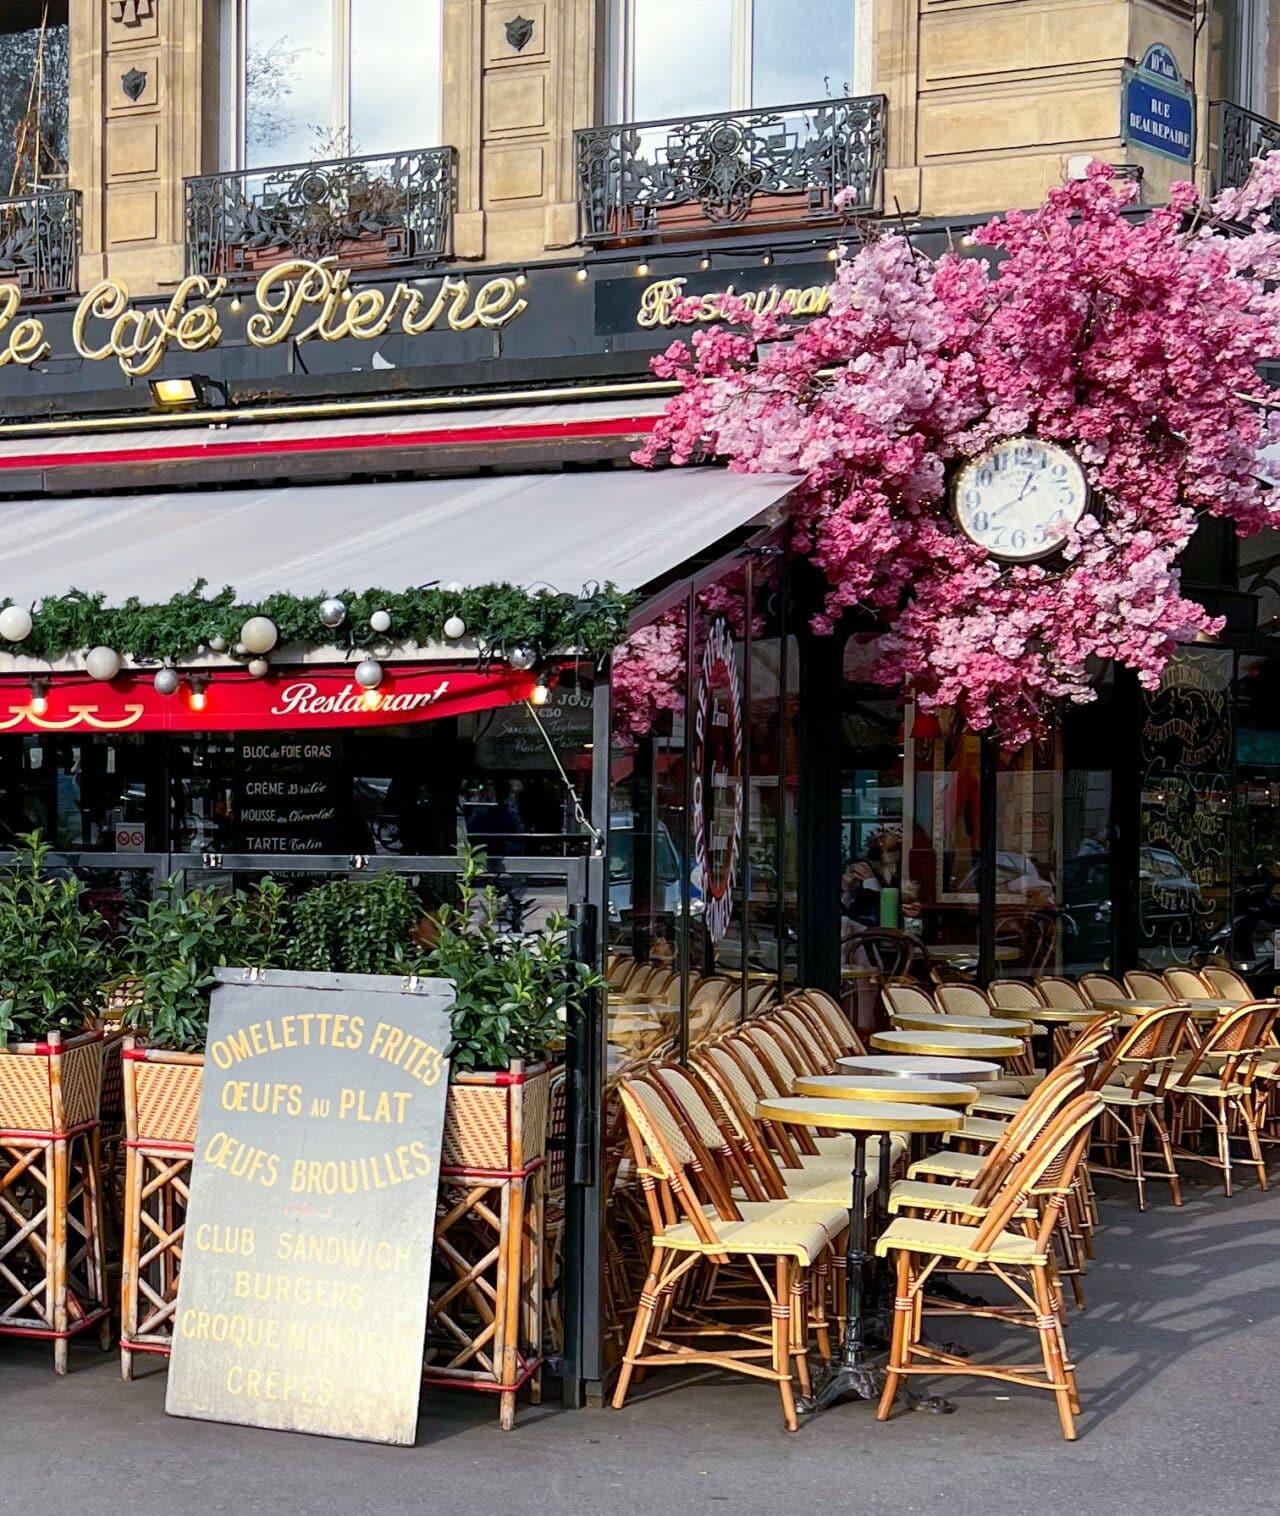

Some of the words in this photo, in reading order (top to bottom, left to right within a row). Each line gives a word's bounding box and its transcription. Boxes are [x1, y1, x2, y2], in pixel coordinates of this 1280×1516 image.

[1151, 98, 1170, 118] RUE
[1129, 112, 1190, 148] BEAUREPAIRE
[73, 274, 225, 376] Café
[246, 255, 528, 347] Pierre
[993, 453, 1008, 471] 11
[1014, 446, 1032, 465] 12
[1042, 453, 1047, 468] 1
[975, 468, 992, 487] 10
[1052, 464, 1068, 483] 2
[966, 490, 981, 509] 9
[1059, 487, 1075, 505] 3
[973, 511, 988, 531] 8
[992, 527, 1006, 544] 7
[1011, 530, 1026, 549] 6
[1033, 525, 1048, 544] 5
[242, 745, 270, 758] BLOC
[281, 745, 302, 758] FOIE
[304, 745, 331, 758] GRAS
[241, 809, 276, 822] MOUSSE
[246, 837, 287, 850] TARTE
[211, 1013, 365, 1069] OMELETTES
[369, 1022, 446, 1087] FRITES
[221, 1080, 302, 1116] ŒUFS
[310, 1099, 330, 1118] AU
[339, 1088, 412, 1123] PLAT
[290, 1141, 432, 1195] BROUILLES
[196, 1223, 255, 1255] CLUB
[277, 1232, 412, 1272] SANDWCH
[234, 1270, 363, 1311] BURGERS
[181, 1309, 280, 1349] CROQUE
